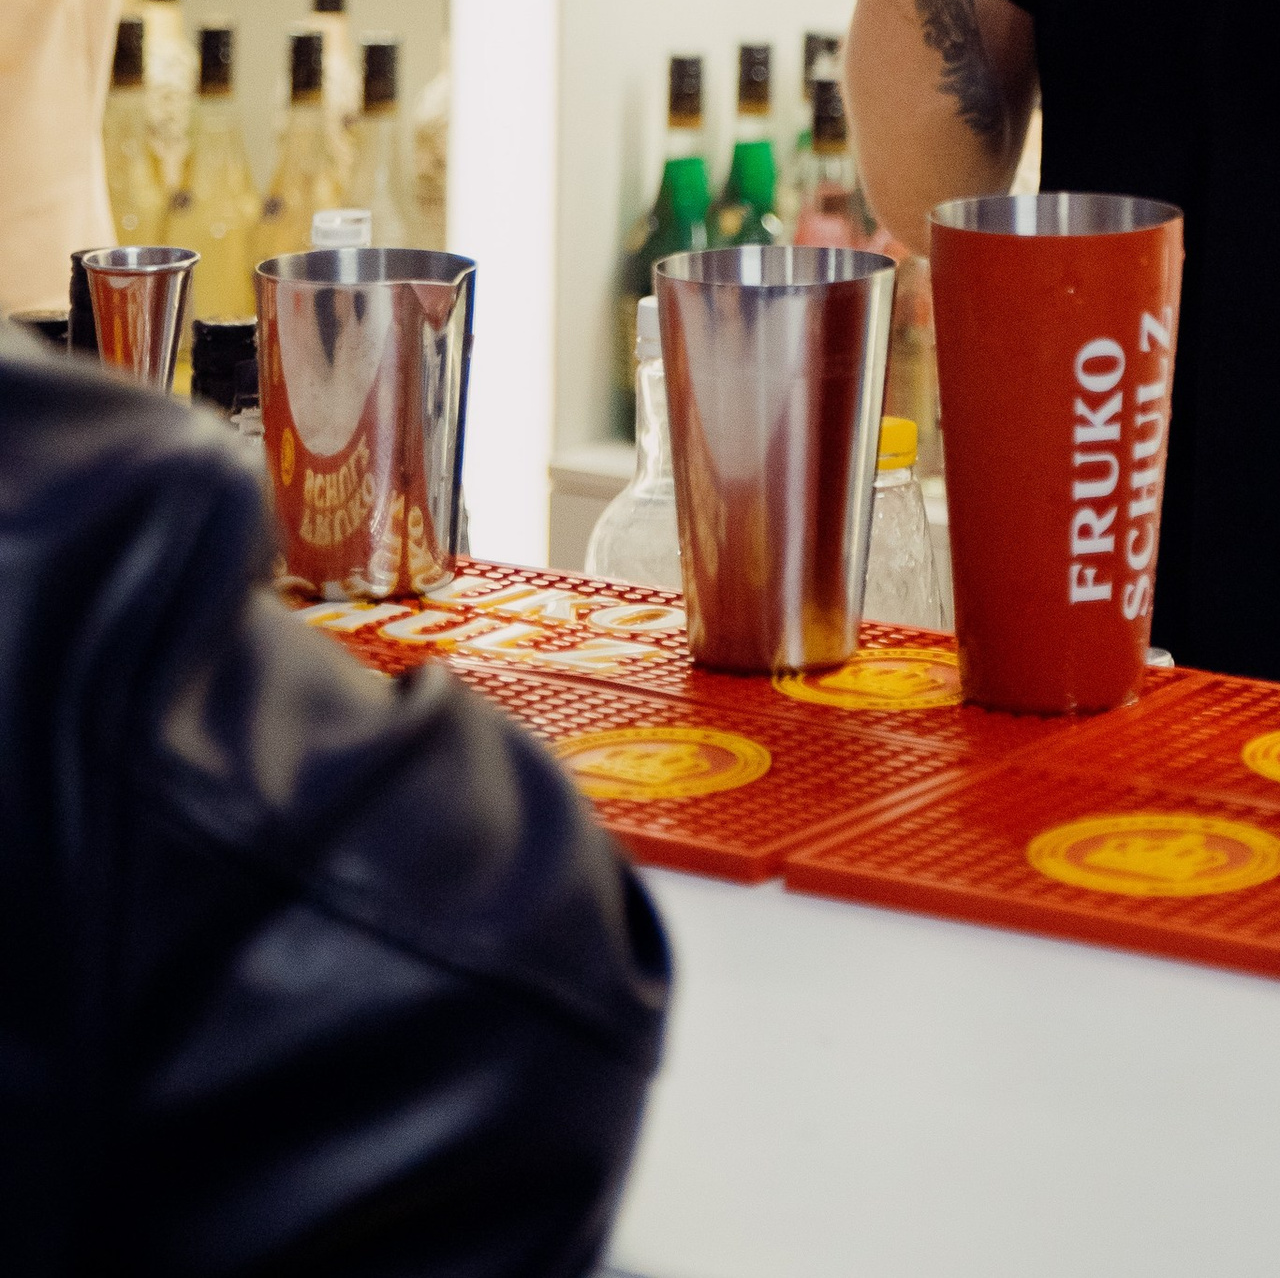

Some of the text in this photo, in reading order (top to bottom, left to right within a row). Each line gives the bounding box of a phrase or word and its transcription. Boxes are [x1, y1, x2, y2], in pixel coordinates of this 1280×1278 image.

[1070, 337, 1127, 605] FRUKO
[1122, 305, 1173, 621] SCHULZ
[304, 599, 663, 671] HULZ
